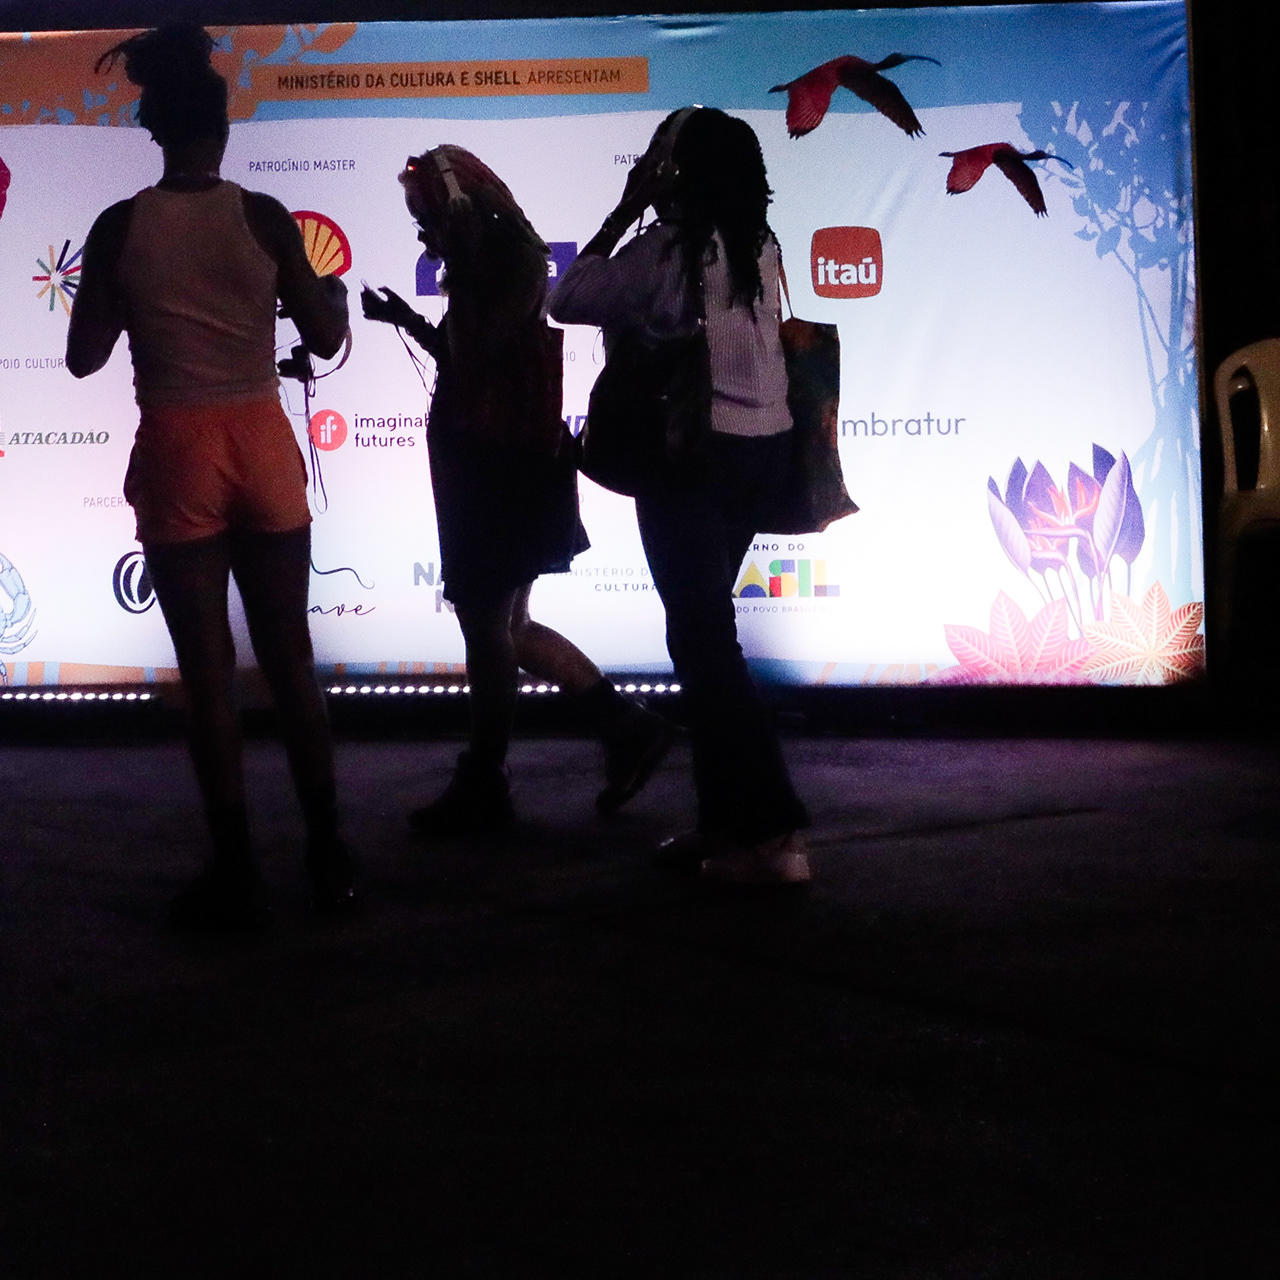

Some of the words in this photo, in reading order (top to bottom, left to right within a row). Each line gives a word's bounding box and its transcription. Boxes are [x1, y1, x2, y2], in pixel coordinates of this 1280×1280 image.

[277, 71, 360, 90] MINISTÉRIO
[365, 73, 386, 88] DA
[390, 71, 456, 88] CULTURA
[460, 72, 470, 86] E
[474, 70, 521, 86] SHELL
[527, 68, 621, 84] APRESENTAM
[249, 158, 310, 172] PATROCÍNIO
[313, 159, 356, 171] MASTER
[817, 256, 877, 286] itaú
[25, 357, 68, 369] CULTUR
[842, 411, 966, 436] mbratur
[354, 432, 416, 448] futures
[788, 543, 805, 551] DO
[553, 566, 634, 577] NISTÉRIO
[753, 605, 778, 613] POVO
